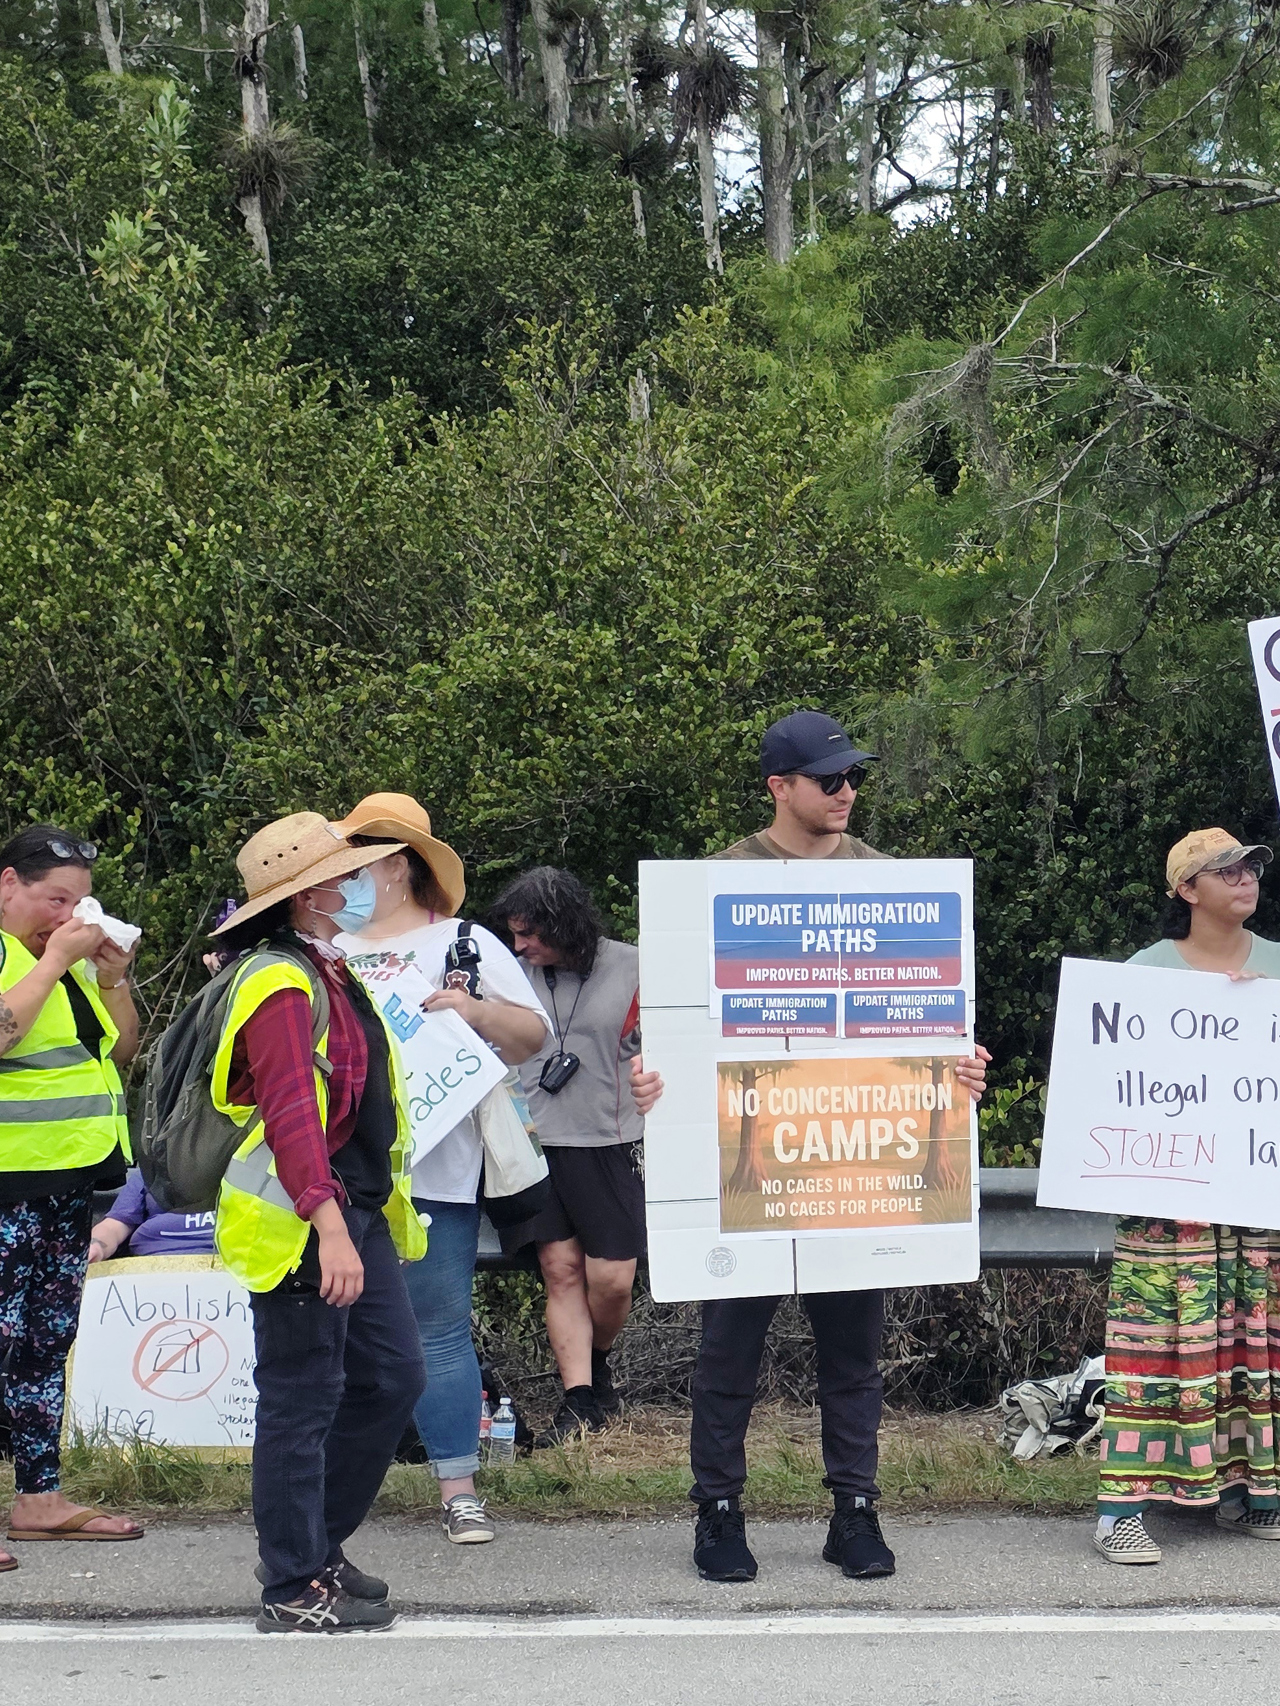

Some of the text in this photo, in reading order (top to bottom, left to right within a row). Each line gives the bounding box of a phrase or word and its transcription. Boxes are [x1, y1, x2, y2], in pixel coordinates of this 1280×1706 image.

[731, 902, 940, 926] UPDATE IMMIGRATION
[801, 928, 877, 953] PATHS
[746, 966, 942, 982] IMPROVED PATHS. BETTER NATION.
[730, 997, 827, 1009] UPDATE IMMIGRATION
[853, 994, 955, 1006] UPDATE IMMIGRATION
[762, 1009, 797, 1021] PATHS
[886, 1007, 924, 1020] PATHS
[1092, 1002, 1146, 1045] No
[1170, 1008, 1240, 1041] One
[409, 1048, 482, 1132] ades
[728, 1083, 952, 1118] NO CONCENTRATION
[1116, 1070, 1279, 1117] illegal on
[773, 1117, 920, 1164] CAMPS
[1083, 1126, 1216, 1169] STOLEN
[761, 1174, 928, 1196] NO CAGES IN THE WILD.
[765, 1196, 923, 1218] NO CAGES FOR PEOPLE
[100, 1280, 247, 1327] Abolish
